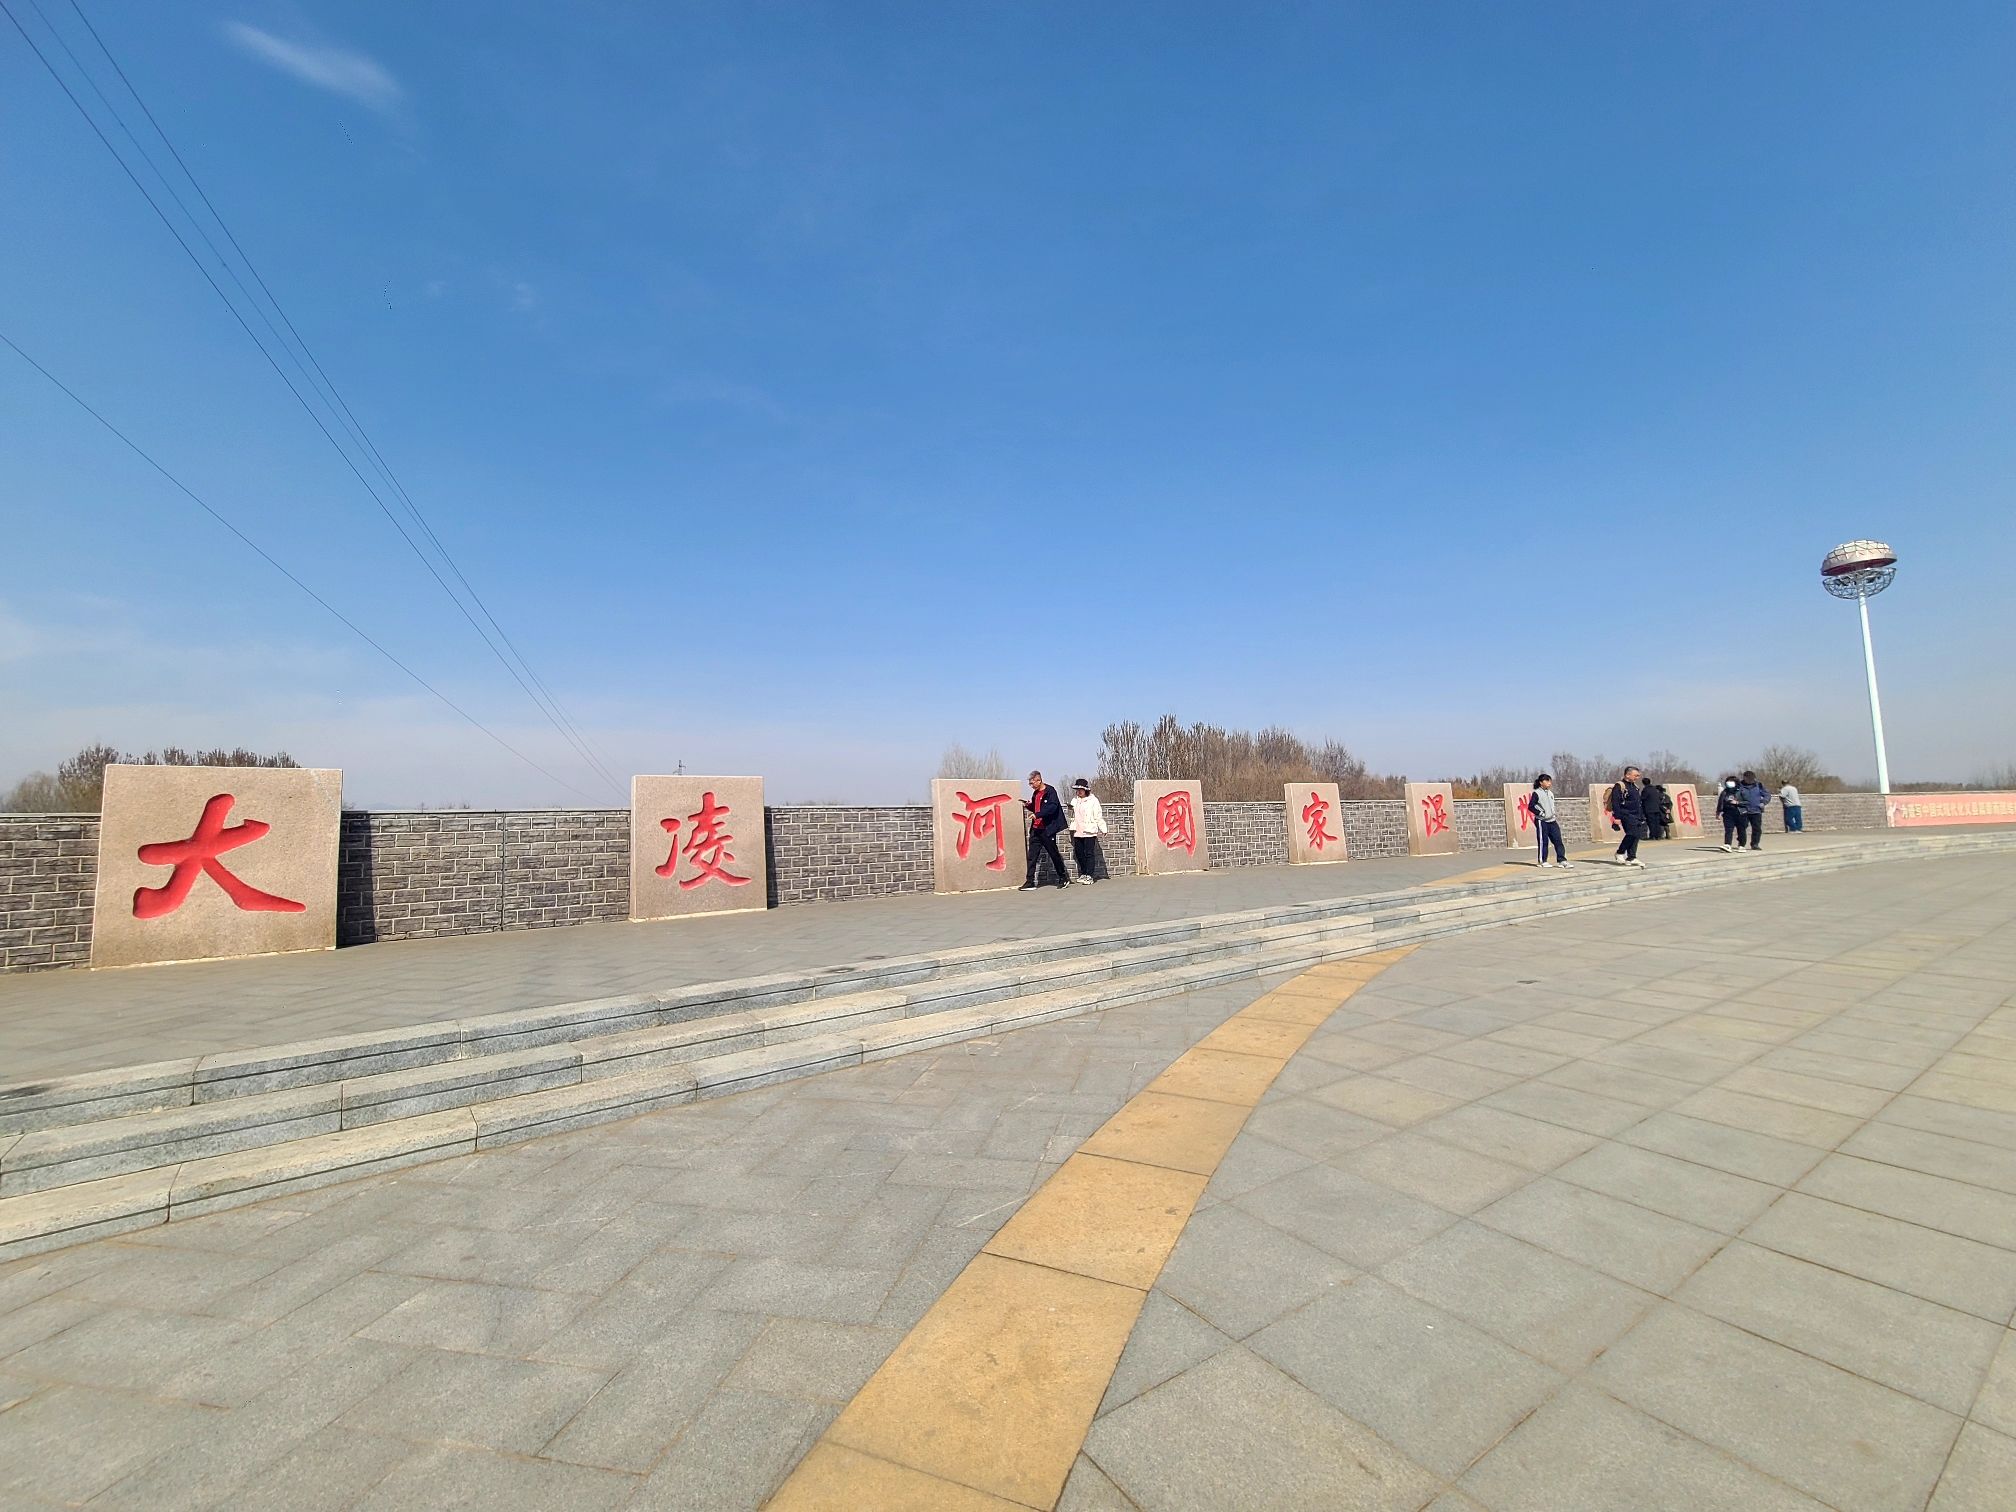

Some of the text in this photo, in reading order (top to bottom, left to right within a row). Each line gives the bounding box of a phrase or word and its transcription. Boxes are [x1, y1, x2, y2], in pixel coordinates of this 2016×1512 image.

[133, 793, 306, 920] 大
[952, 791, 1013, 871] 河
[1302, 791, 1338, 851] 家
